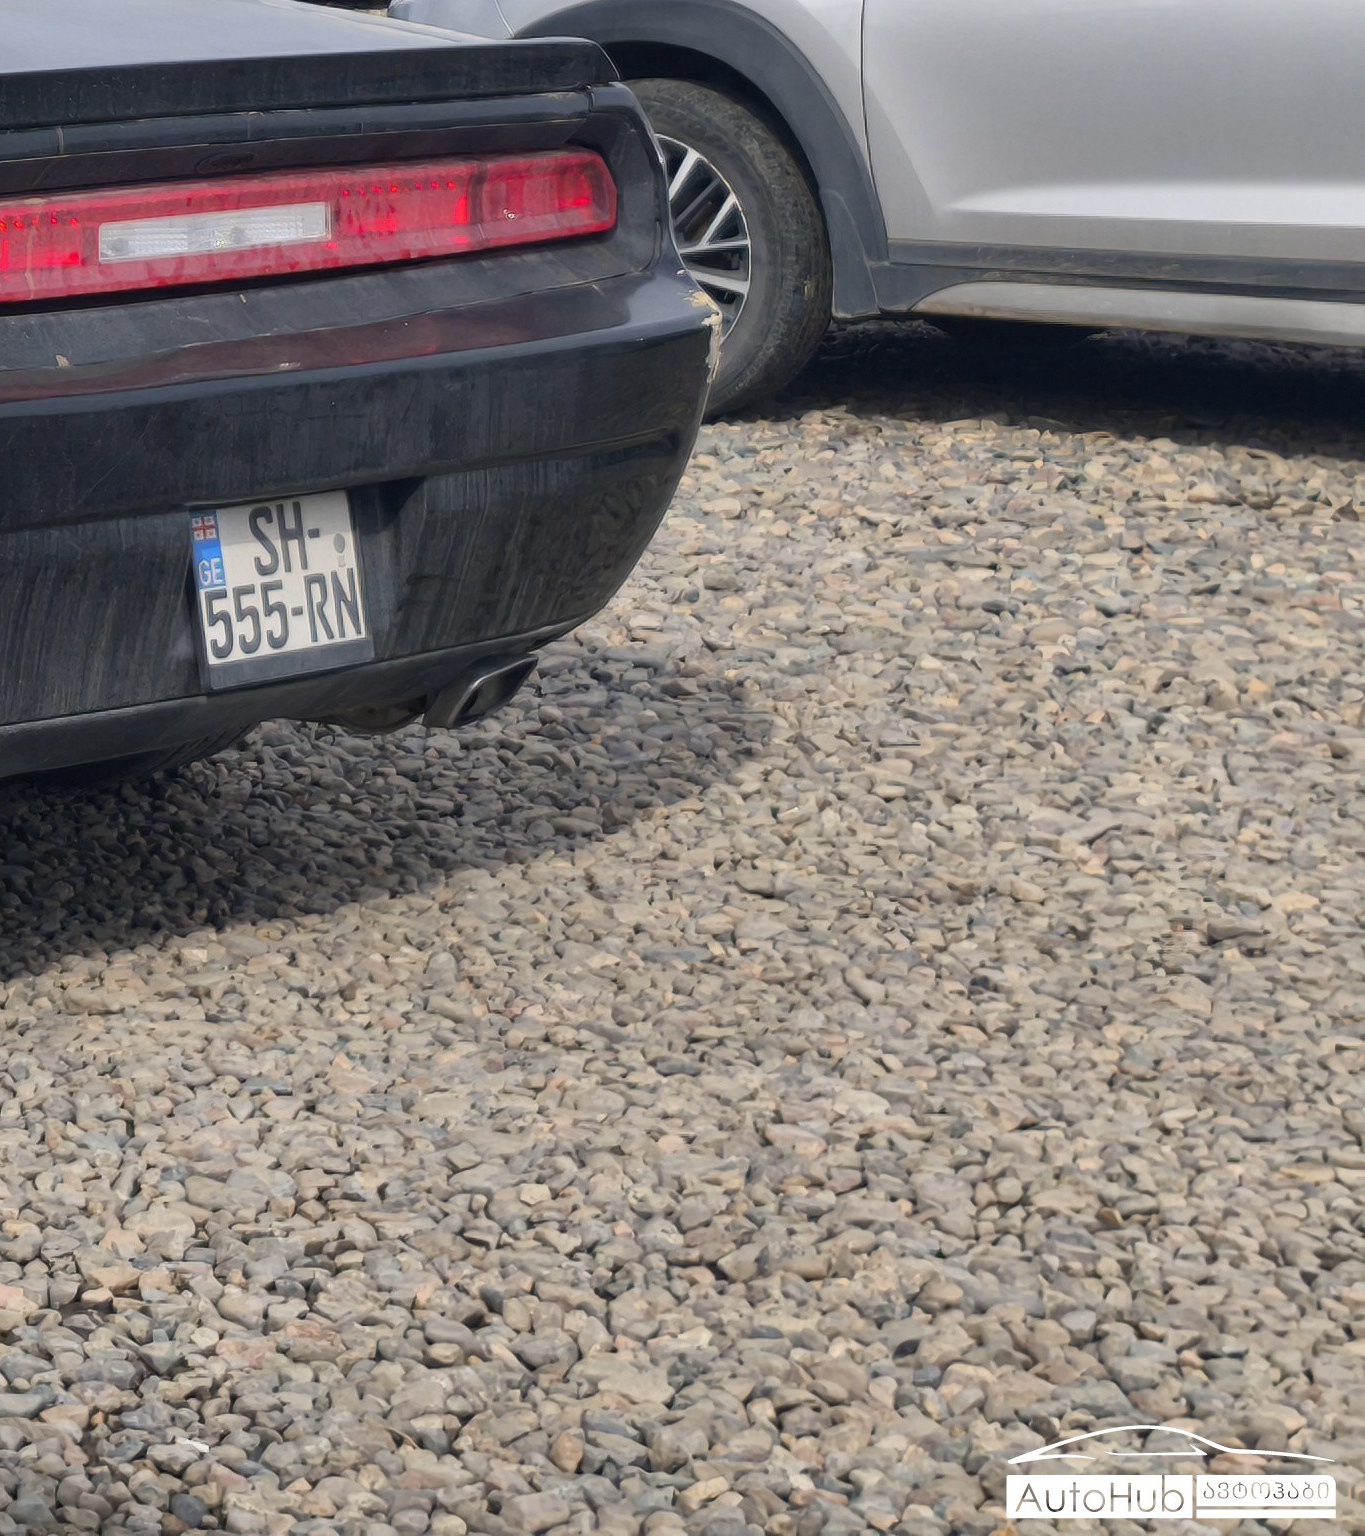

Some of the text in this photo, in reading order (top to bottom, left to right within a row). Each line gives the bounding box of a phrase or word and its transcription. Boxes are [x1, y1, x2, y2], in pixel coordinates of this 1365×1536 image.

[198, 557, 224, 585] GE
[248, 501, 321, 576] SH-
[204, 567, 362, 659] 555-RN
